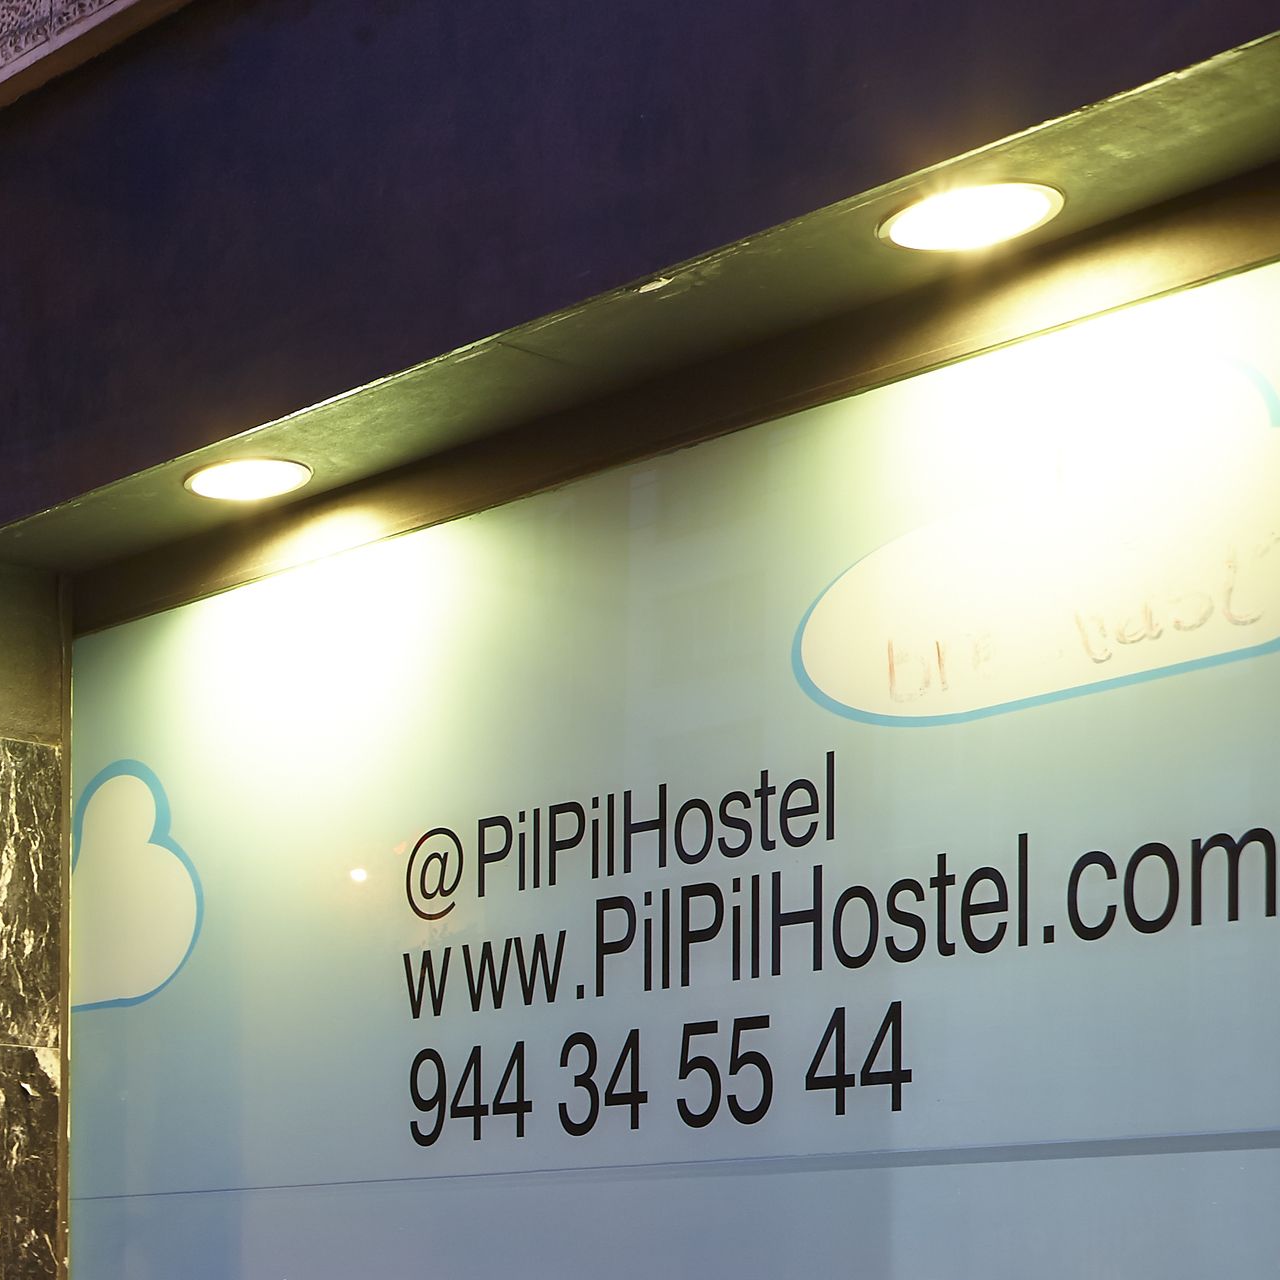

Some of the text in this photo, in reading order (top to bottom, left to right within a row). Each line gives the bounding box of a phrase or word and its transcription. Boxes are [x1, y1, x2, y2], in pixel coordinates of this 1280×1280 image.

[406, 751, 836, 920] @PilPilHostel
[403, 826, 1278, 1019] www.PilPilHostel.com
[409, 1000, 913, 1147] 944 34 55 44
